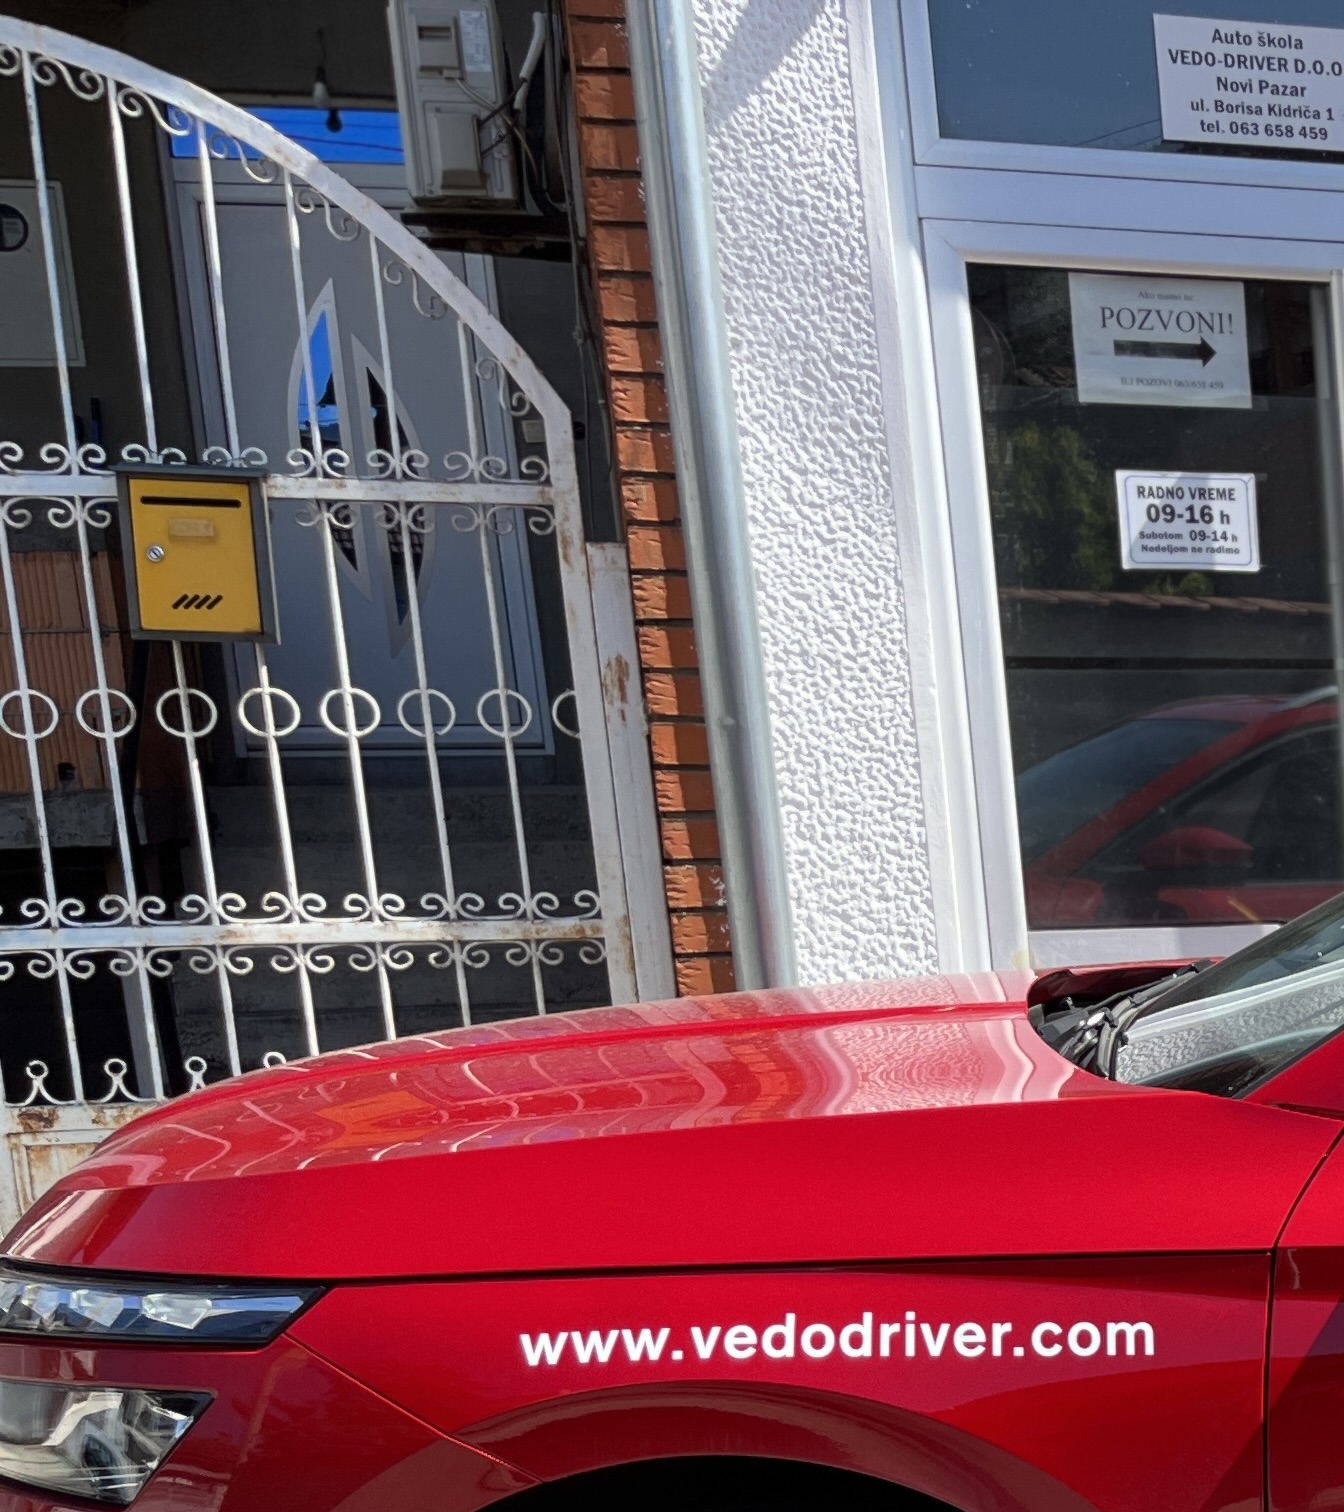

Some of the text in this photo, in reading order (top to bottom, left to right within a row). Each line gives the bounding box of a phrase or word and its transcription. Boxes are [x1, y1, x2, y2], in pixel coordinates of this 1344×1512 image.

[1212, 28, 1304, 50] Auto škola
[1168, 48, 1290, 73] VEDO-DRIVER
[1216, 76, 1307, 98] Novi Pazar
[1190, 99, 1335, 121] ul. Borisa Kidriča 1
[1200, 120, 1329, 141] tel. 063 658 459
[1099, 306, 1234, 335] POZVONI!
[1137, 485, 1236, 501] RADNO VREME
[1146, 503, 1231, 524] 09-16 h
[1139, 531, 1183, 540] Subotom
[1189, 529, 1229, 542] 09-14
[1205, 546, 1240, 554] radimo
[519, 1311, 1156, 1367] www.vedodriver.com
